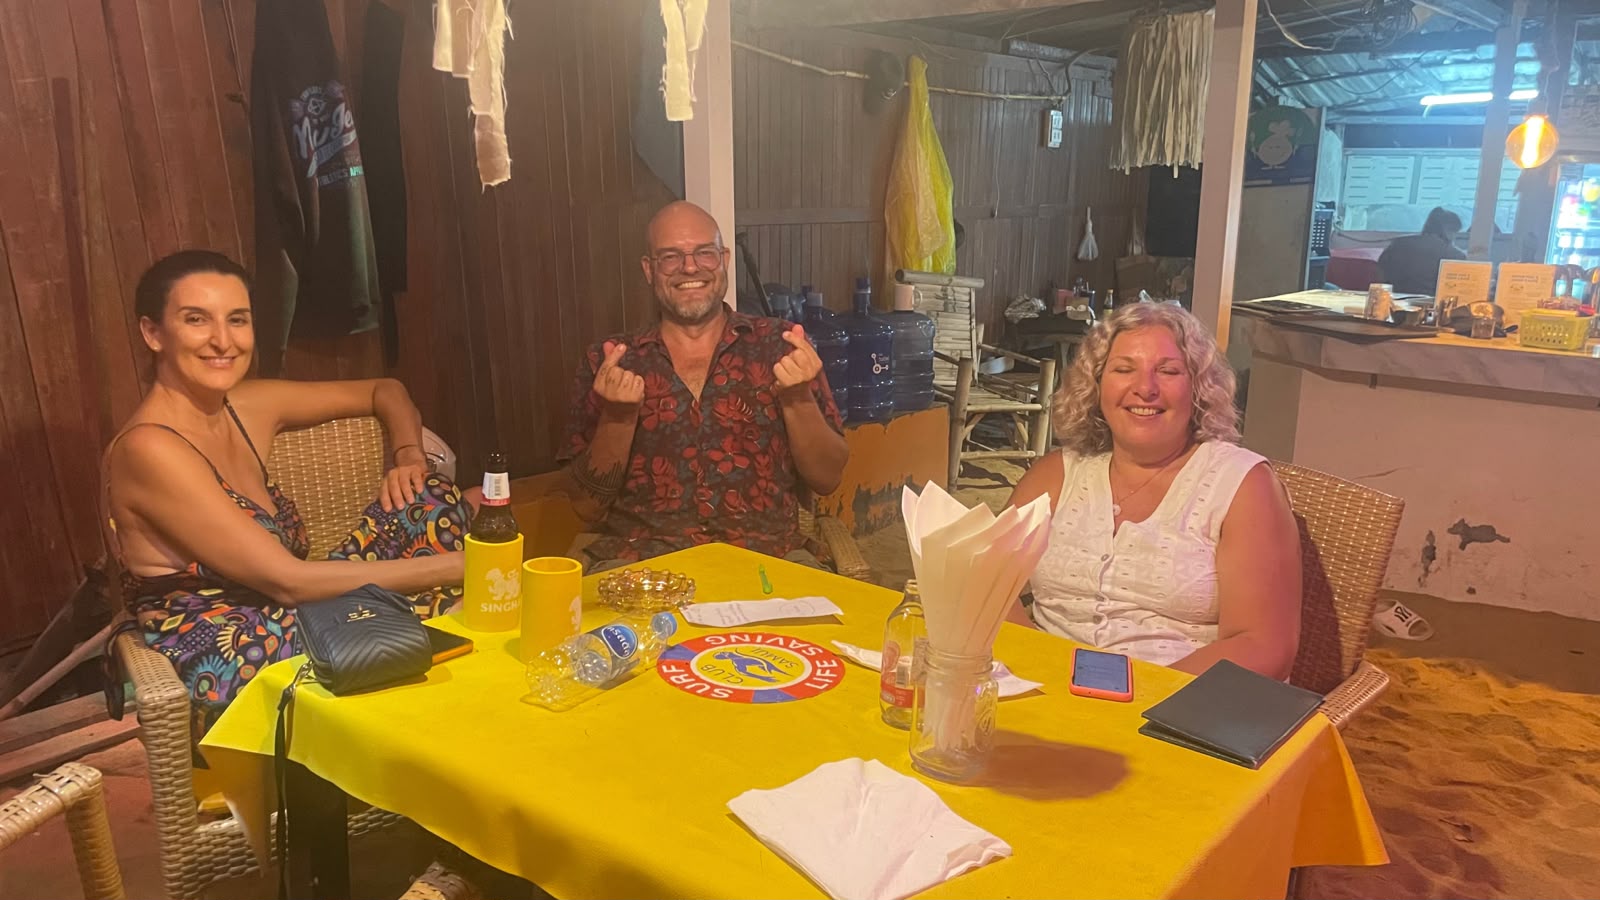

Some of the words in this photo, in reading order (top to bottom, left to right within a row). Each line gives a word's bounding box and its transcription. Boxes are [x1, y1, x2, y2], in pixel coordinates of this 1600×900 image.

[704, 633, 824, 657] SAVING
[751, 648, 799, 669] SAMUI
[662, 664, 734, 699] SURF
[700, 664, 744, 684] CLUB
[805, 659, 838, 690] LIFE
